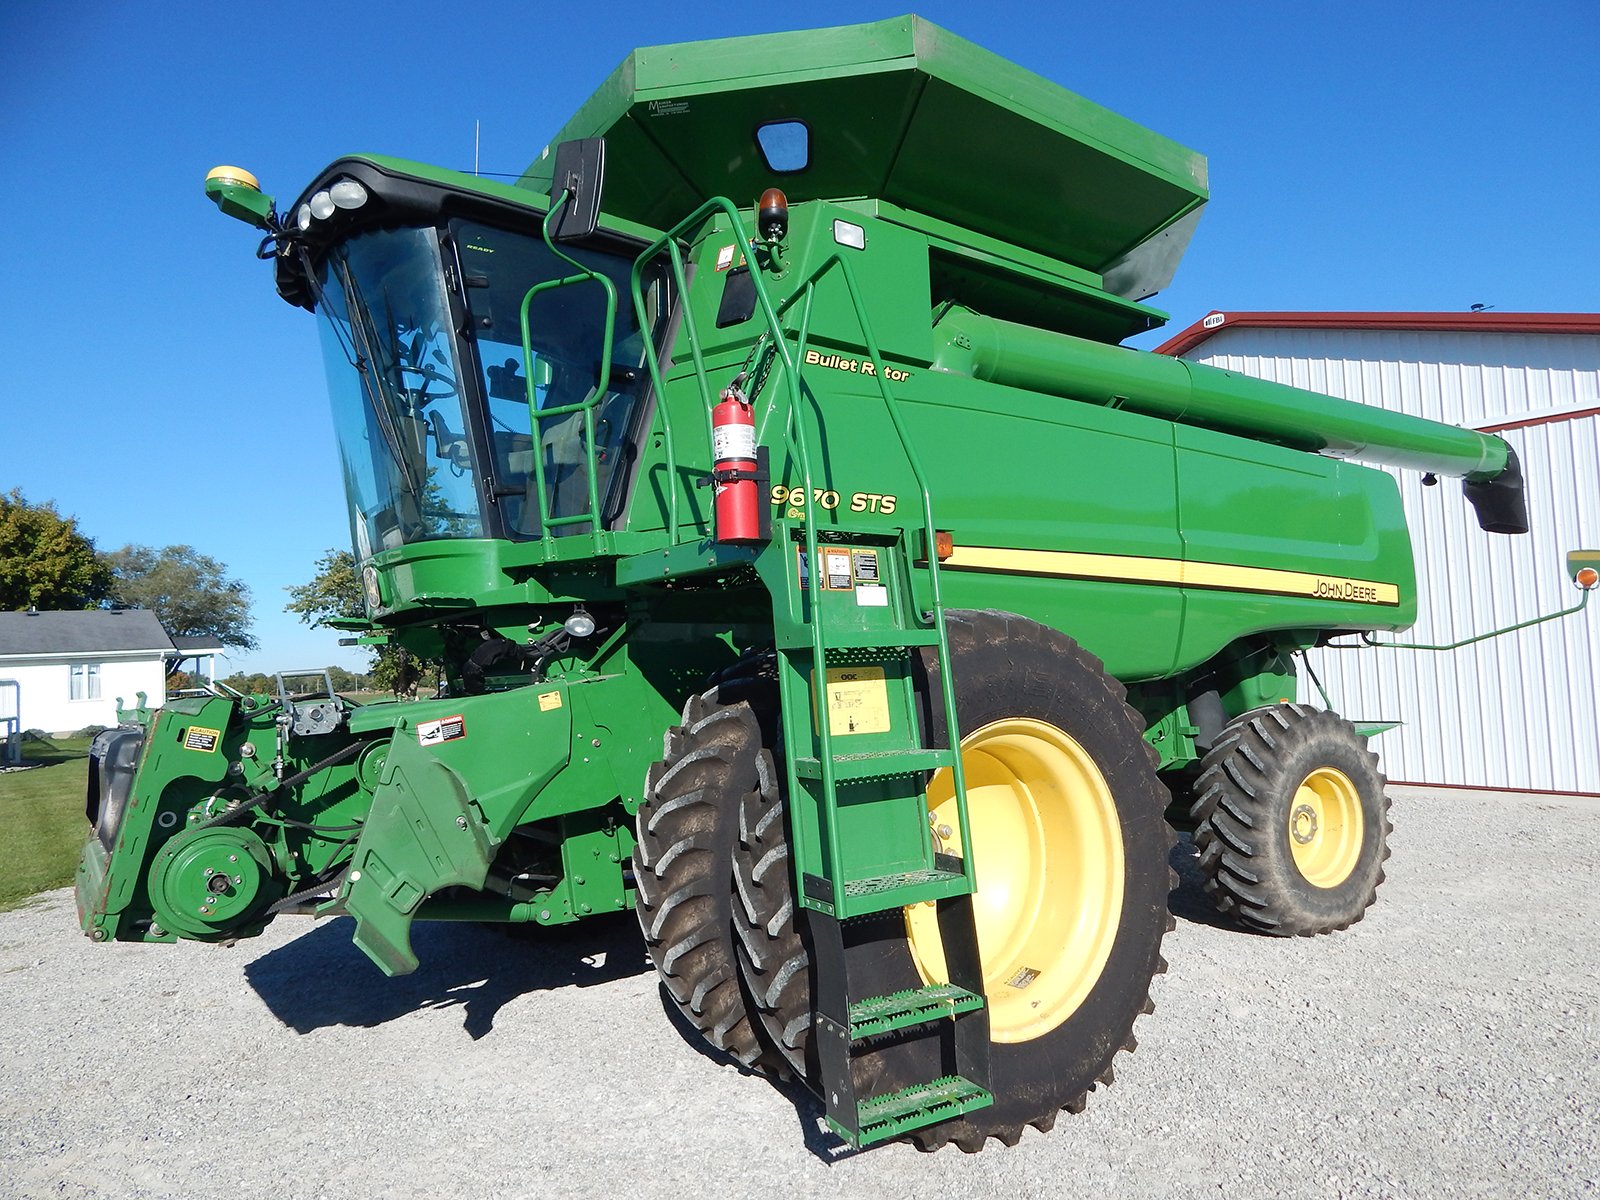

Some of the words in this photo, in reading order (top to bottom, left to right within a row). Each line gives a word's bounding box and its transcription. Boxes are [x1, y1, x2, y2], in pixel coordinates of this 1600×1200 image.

[466, 244, 494, 253] READY
[805, 350, 858, 372] Bullet
[850, 491, 898, 515] STS
[1313, 578, 1342, 597] JOHN
[1345, 582, 1377, 600] DEERE
[195, 728, 219, 736] CAUTION
